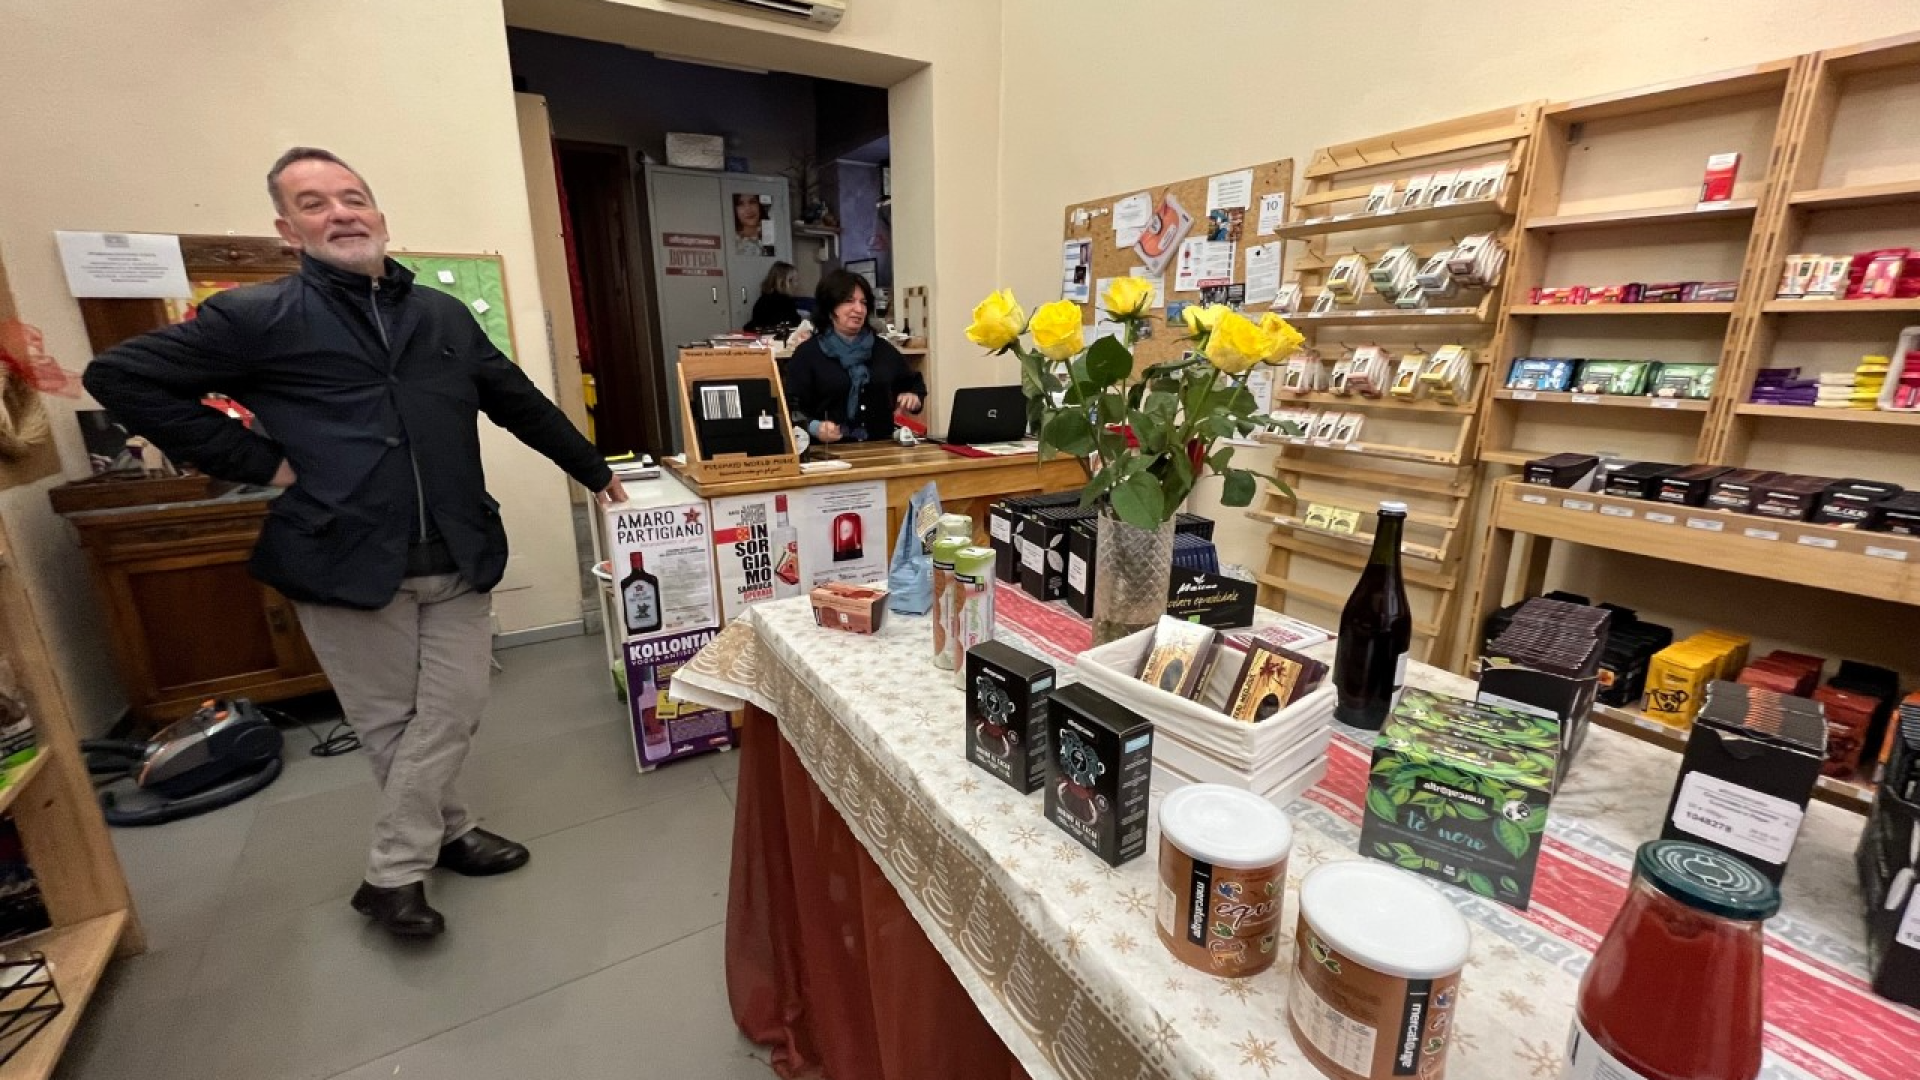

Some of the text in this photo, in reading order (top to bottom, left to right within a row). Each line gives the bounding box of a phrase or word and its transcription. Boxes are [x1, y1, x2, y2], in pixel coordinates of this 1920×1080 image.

[1265, 200, 1279, 211] 10
[617, 510, 675, 530] AMARO
[617, 523, 704, 545] PARTIGIANO
[750, 523, 769, 539] IN
[734, 539, 769, 557] SOR
[742, 553, 772, 571] GIA
[745, 567, 772, 585] MO
[631, 655, 661, 666] VODKA
[1437, 827, 1487, 851] nero
